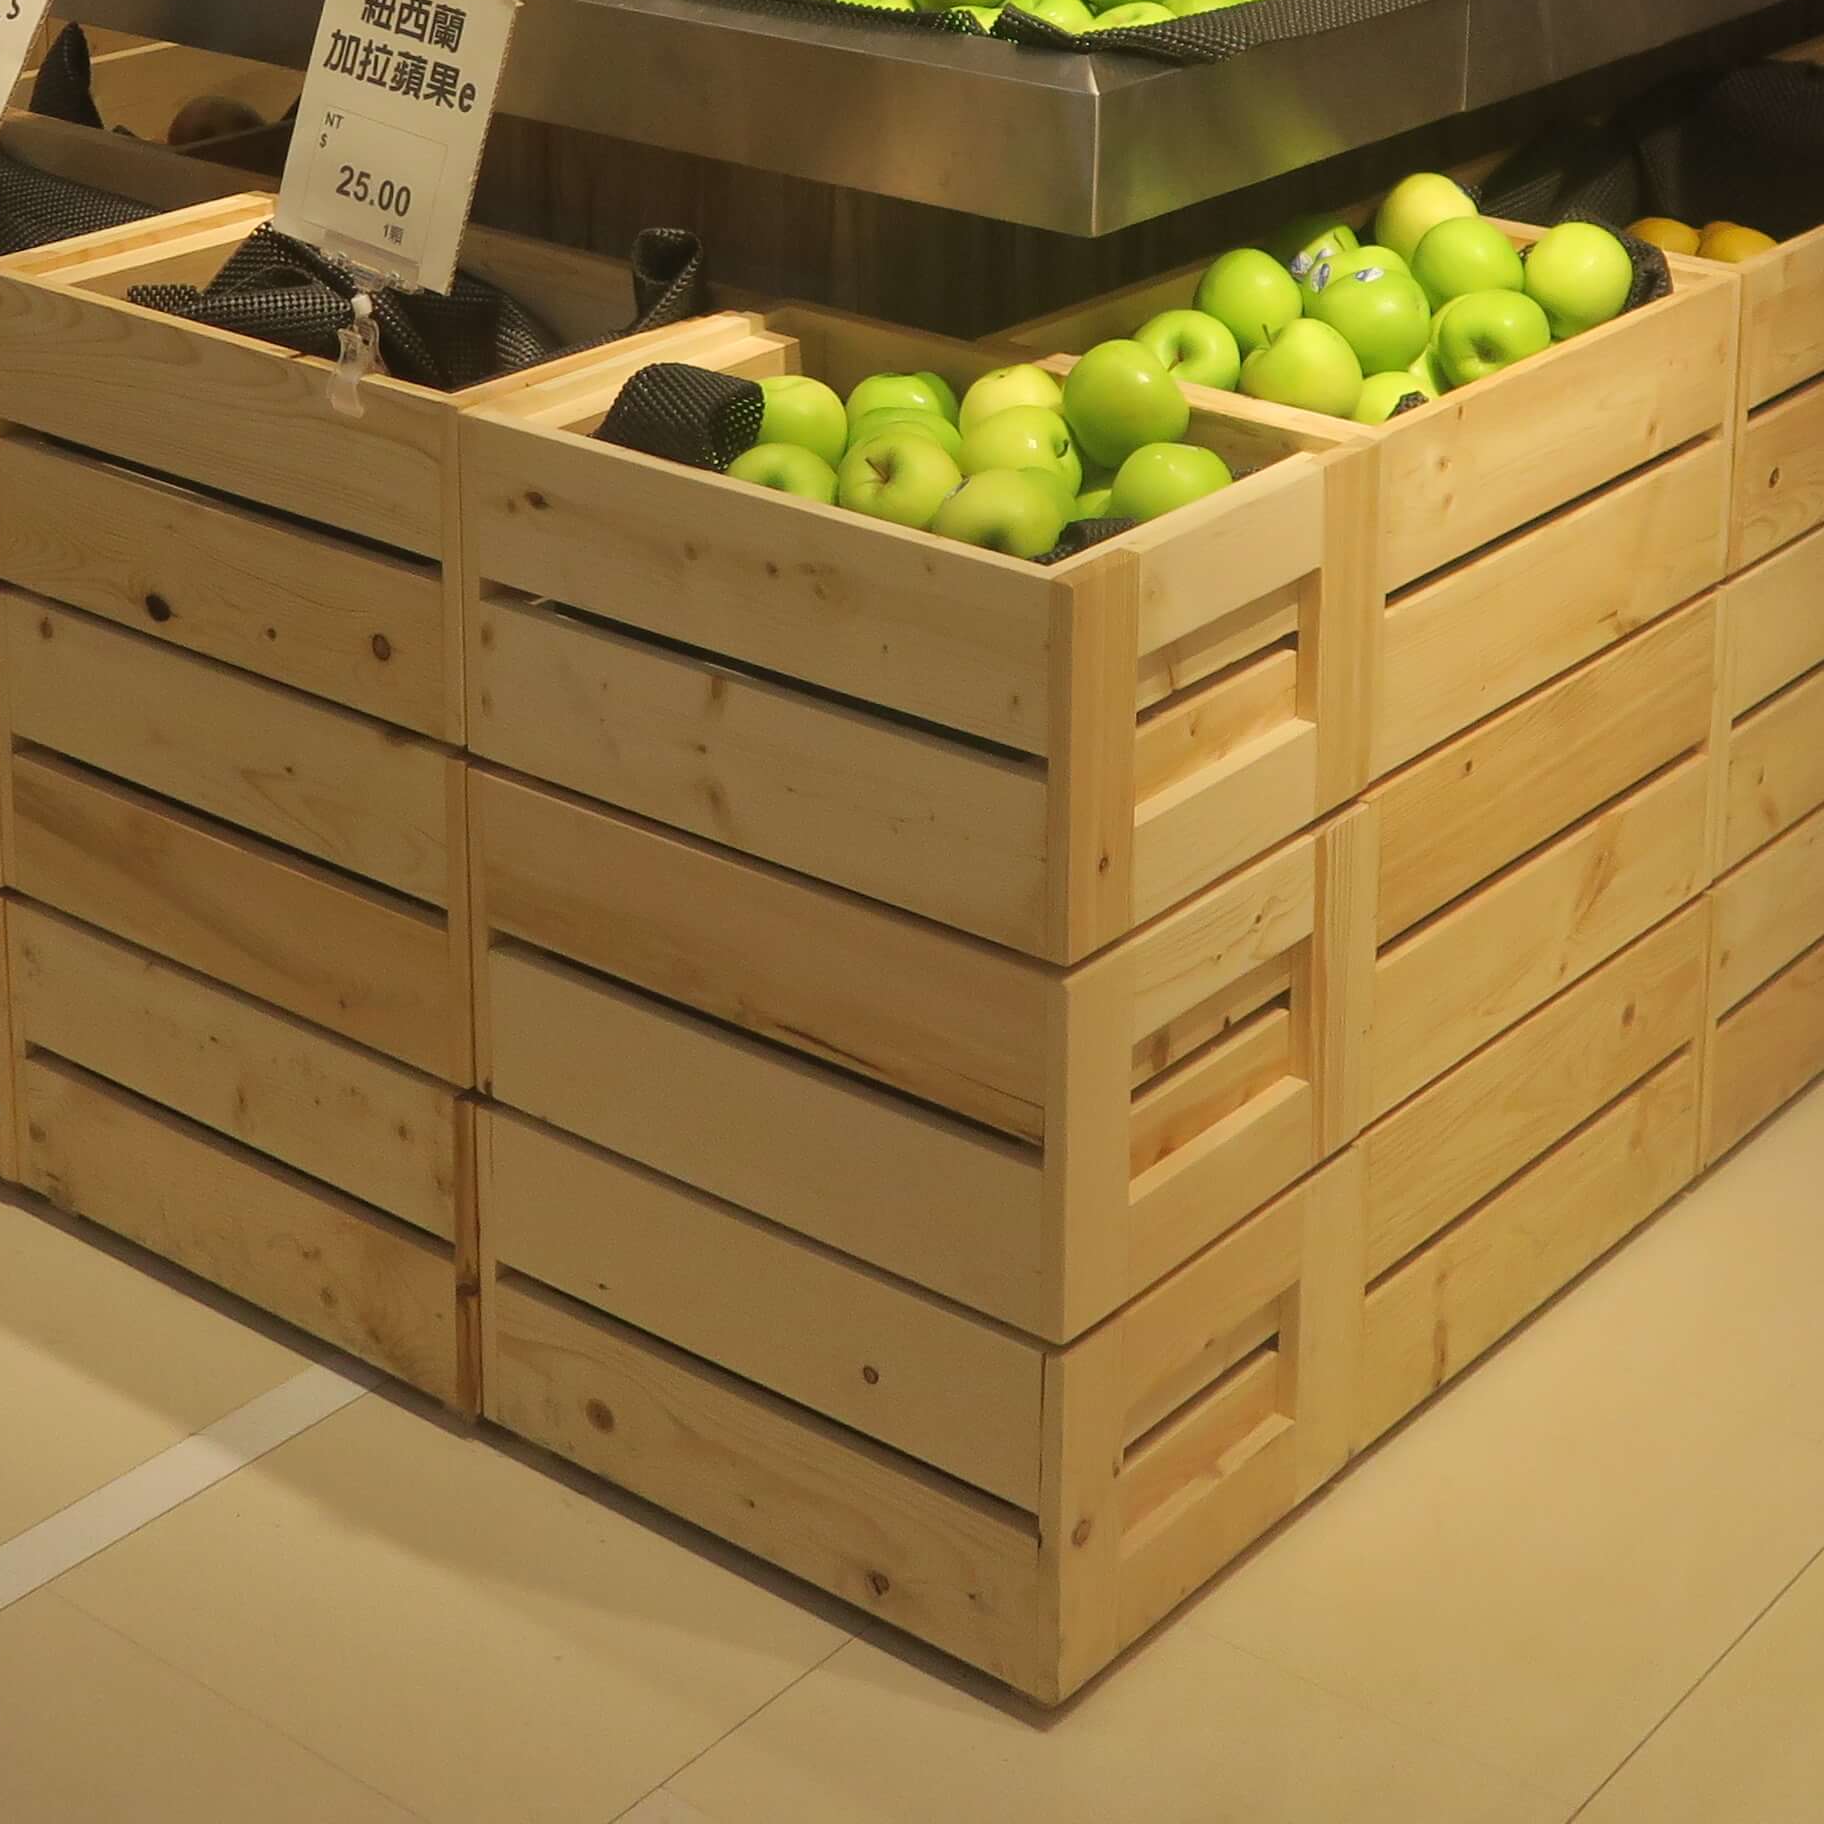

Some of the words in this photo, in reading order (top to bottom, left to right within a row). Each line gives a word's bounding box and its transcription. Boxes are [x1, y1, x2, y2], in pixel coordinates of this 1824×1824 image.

[322, 28, 478, 114] 加拉蘋果e
[324, 111, 345, 130] NT
[318, 132, 328, 150] $
[334, 164, 413, 218] 25.00
